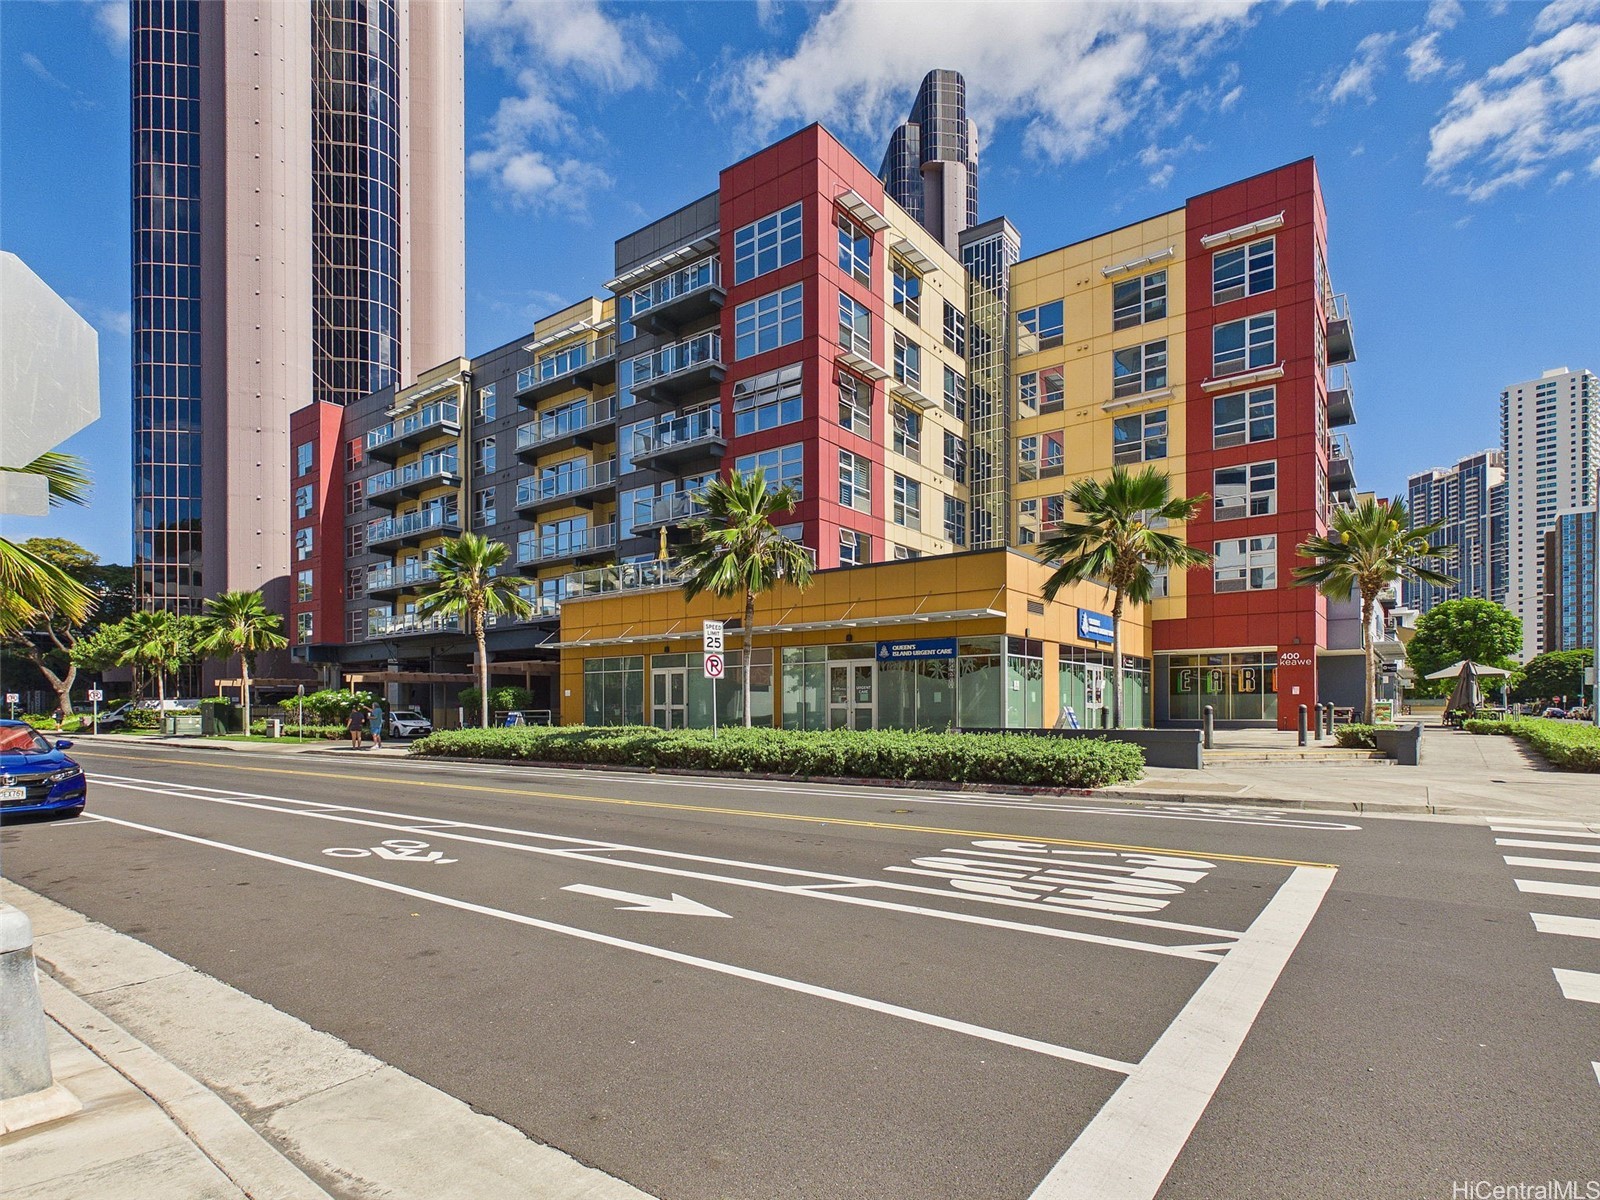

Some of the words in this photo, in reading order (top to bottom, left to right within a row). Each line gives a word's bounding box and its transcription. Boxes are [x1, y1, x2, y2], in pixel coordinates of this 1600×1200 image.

[706, 637, 722, 649] 25
[1280, 658, 1312, 666] keawe
[1281, 652, 1300, 660] 400
[1177, 667, 1278, 694] EAR
[882, 839, 1217, 913] STOP
